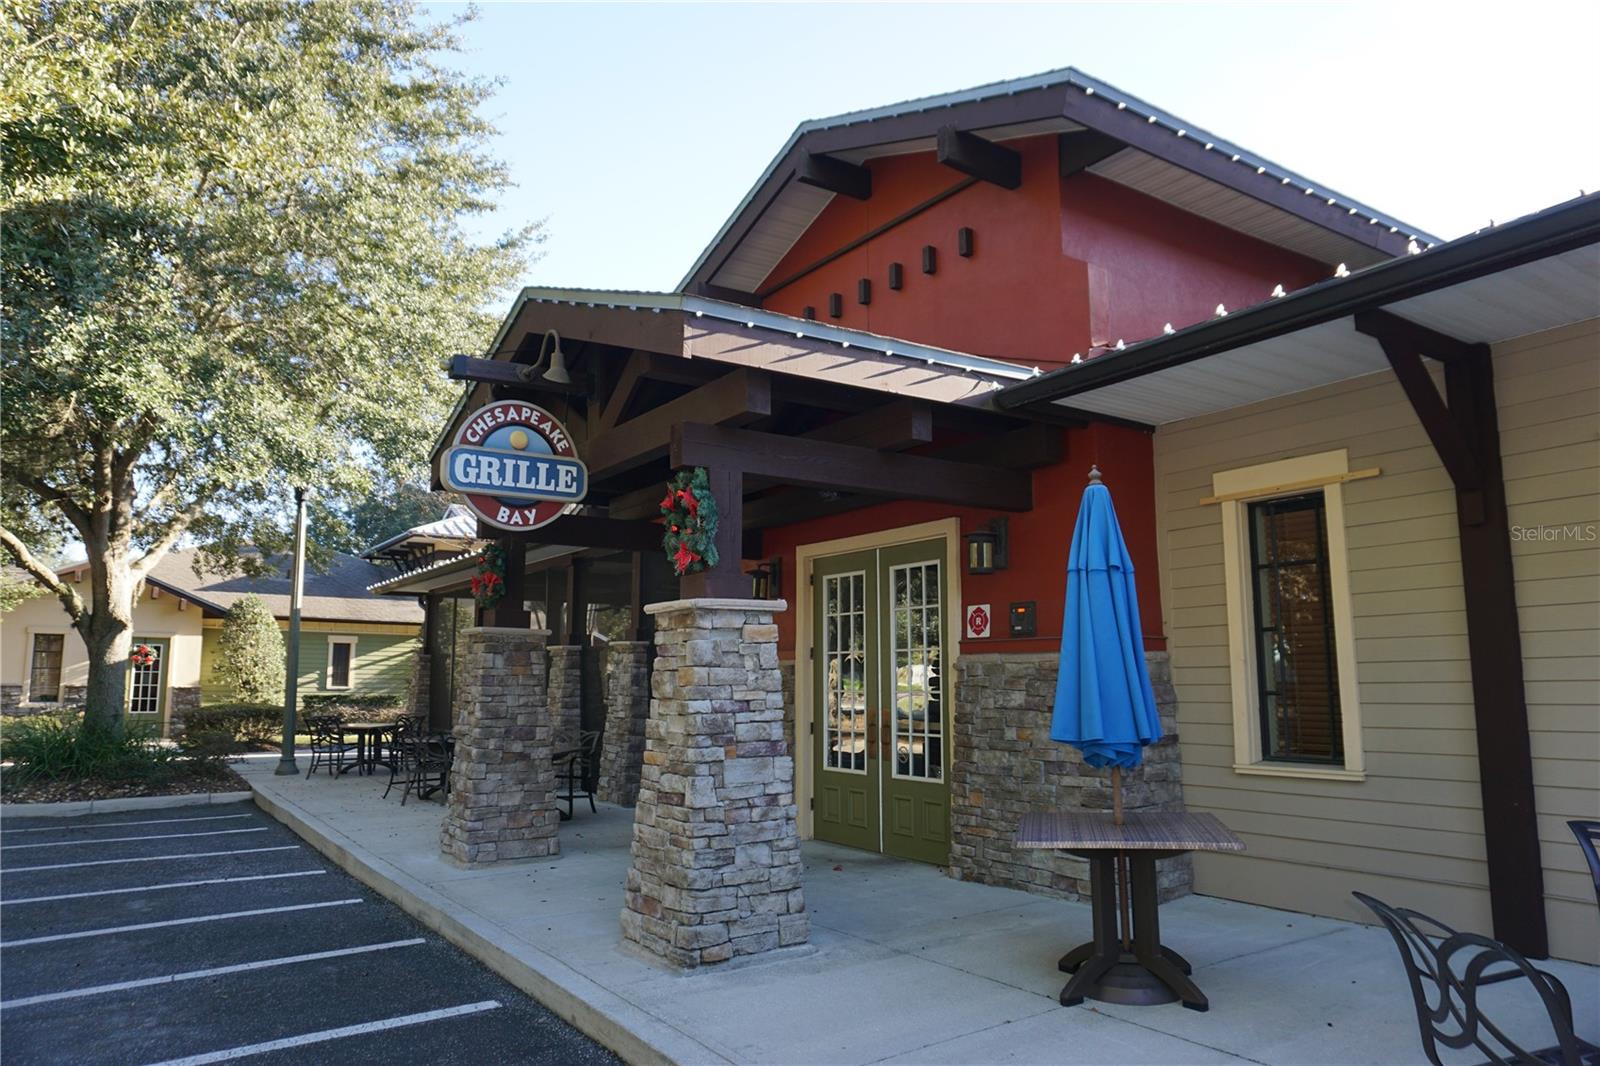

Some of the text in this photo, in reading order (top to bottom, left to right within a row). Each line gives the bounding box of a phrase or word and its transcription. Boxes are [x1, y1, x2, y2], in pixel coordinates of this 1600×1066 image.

[466, 406, 569, 452] CHESAPEAKE
[454, 453, 577, 493] GRILLE
[496, 506, 537, 525] BAY
[975, 617, 982, 626] R
